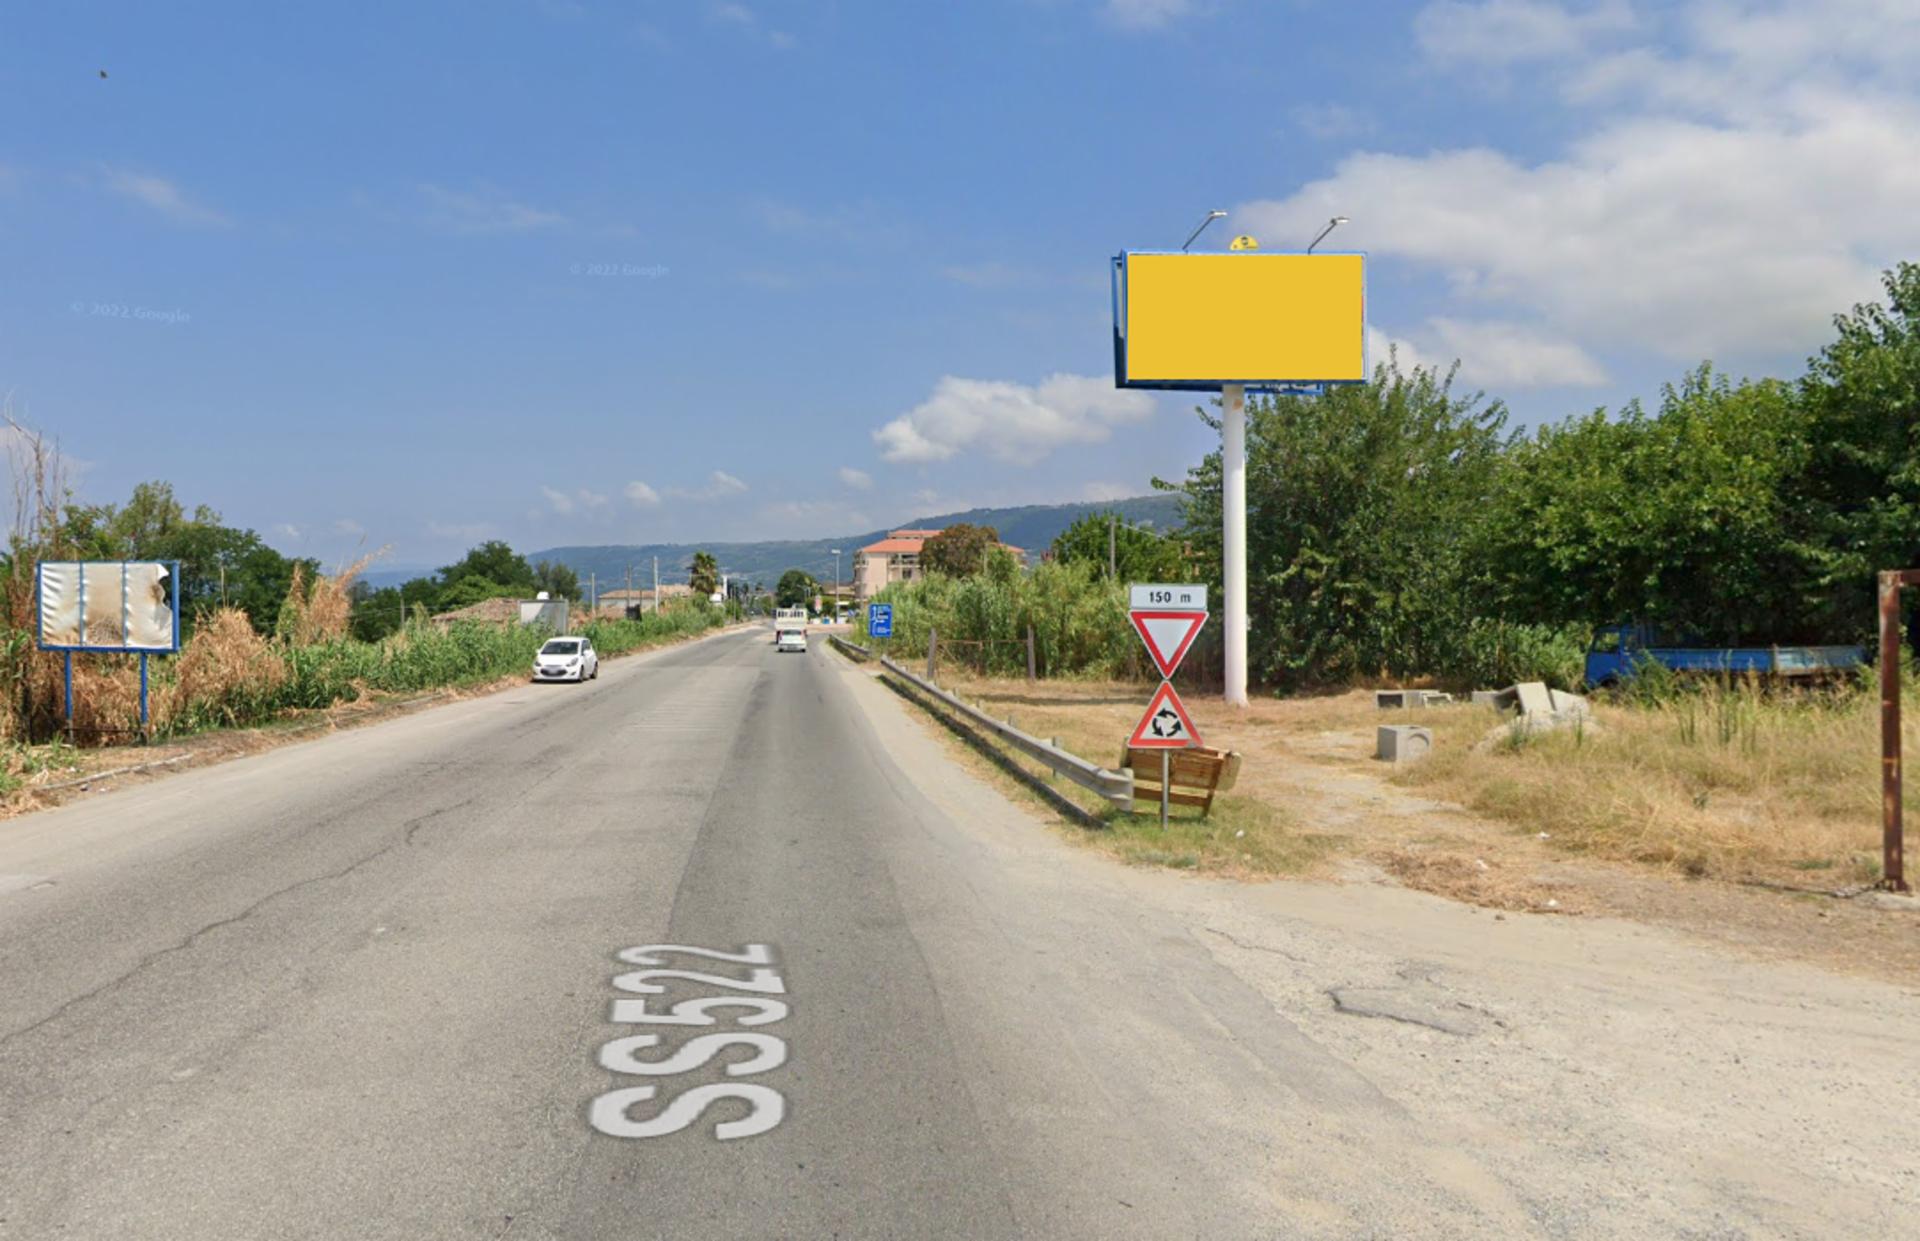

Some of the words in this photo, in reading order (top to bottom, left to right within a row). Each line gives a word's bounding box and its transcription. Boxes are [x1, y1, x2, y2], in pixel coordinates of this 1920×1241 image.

[1149, 591, 1172, 603] 150
[1180, 593, 1191, 603] m
[590, 944, 787, 1140] SS522
